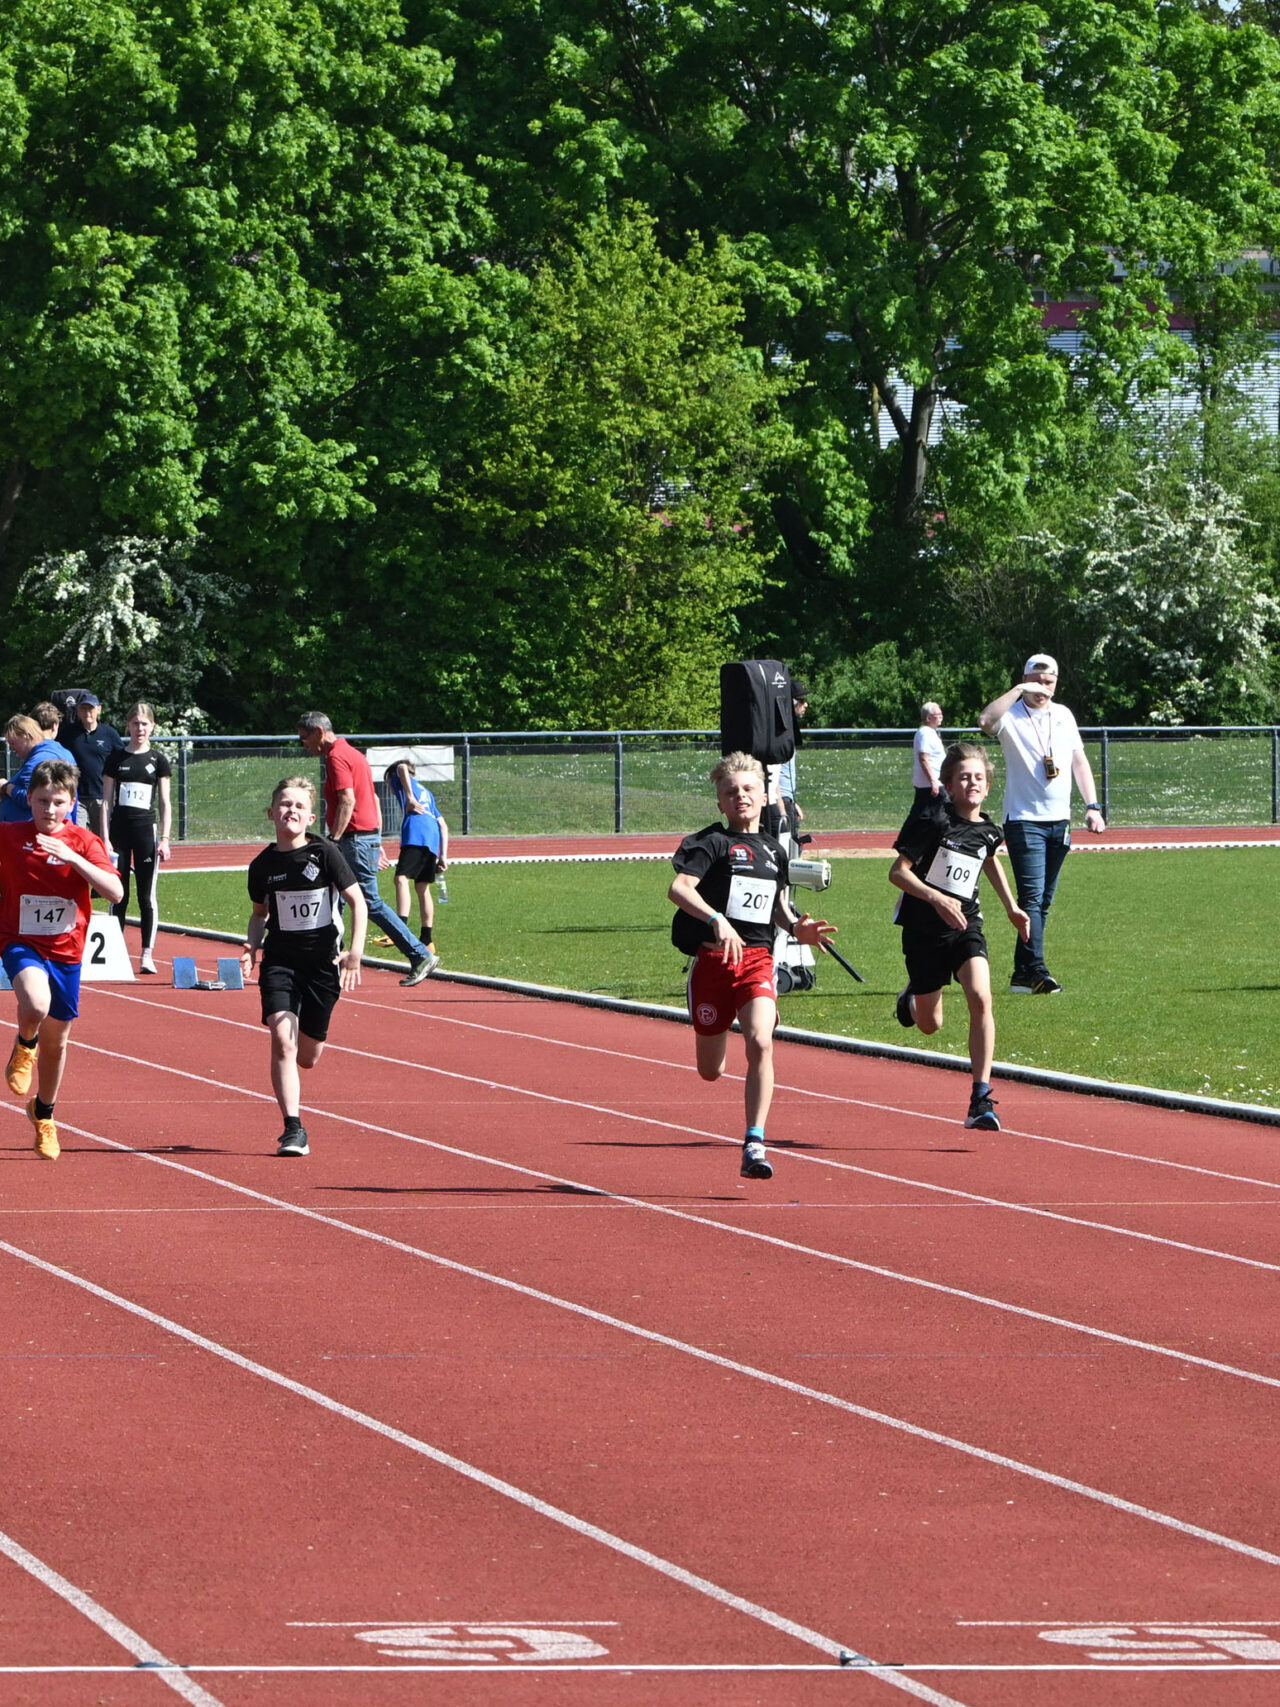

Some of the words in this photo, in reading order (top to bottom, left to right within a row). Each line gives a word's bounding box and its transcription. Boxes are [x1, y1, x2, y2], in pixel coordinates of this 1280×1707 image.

[127, 789, 144, 801] 112
[734, 848, 747, 857] TG
[945, 865, 970, 882] 109
[290, 901, 320, 918] 107
[742, 892, 769, 910] 207
[34, 907, 66, 923] 147
[90, 931, 106, 965] 2
